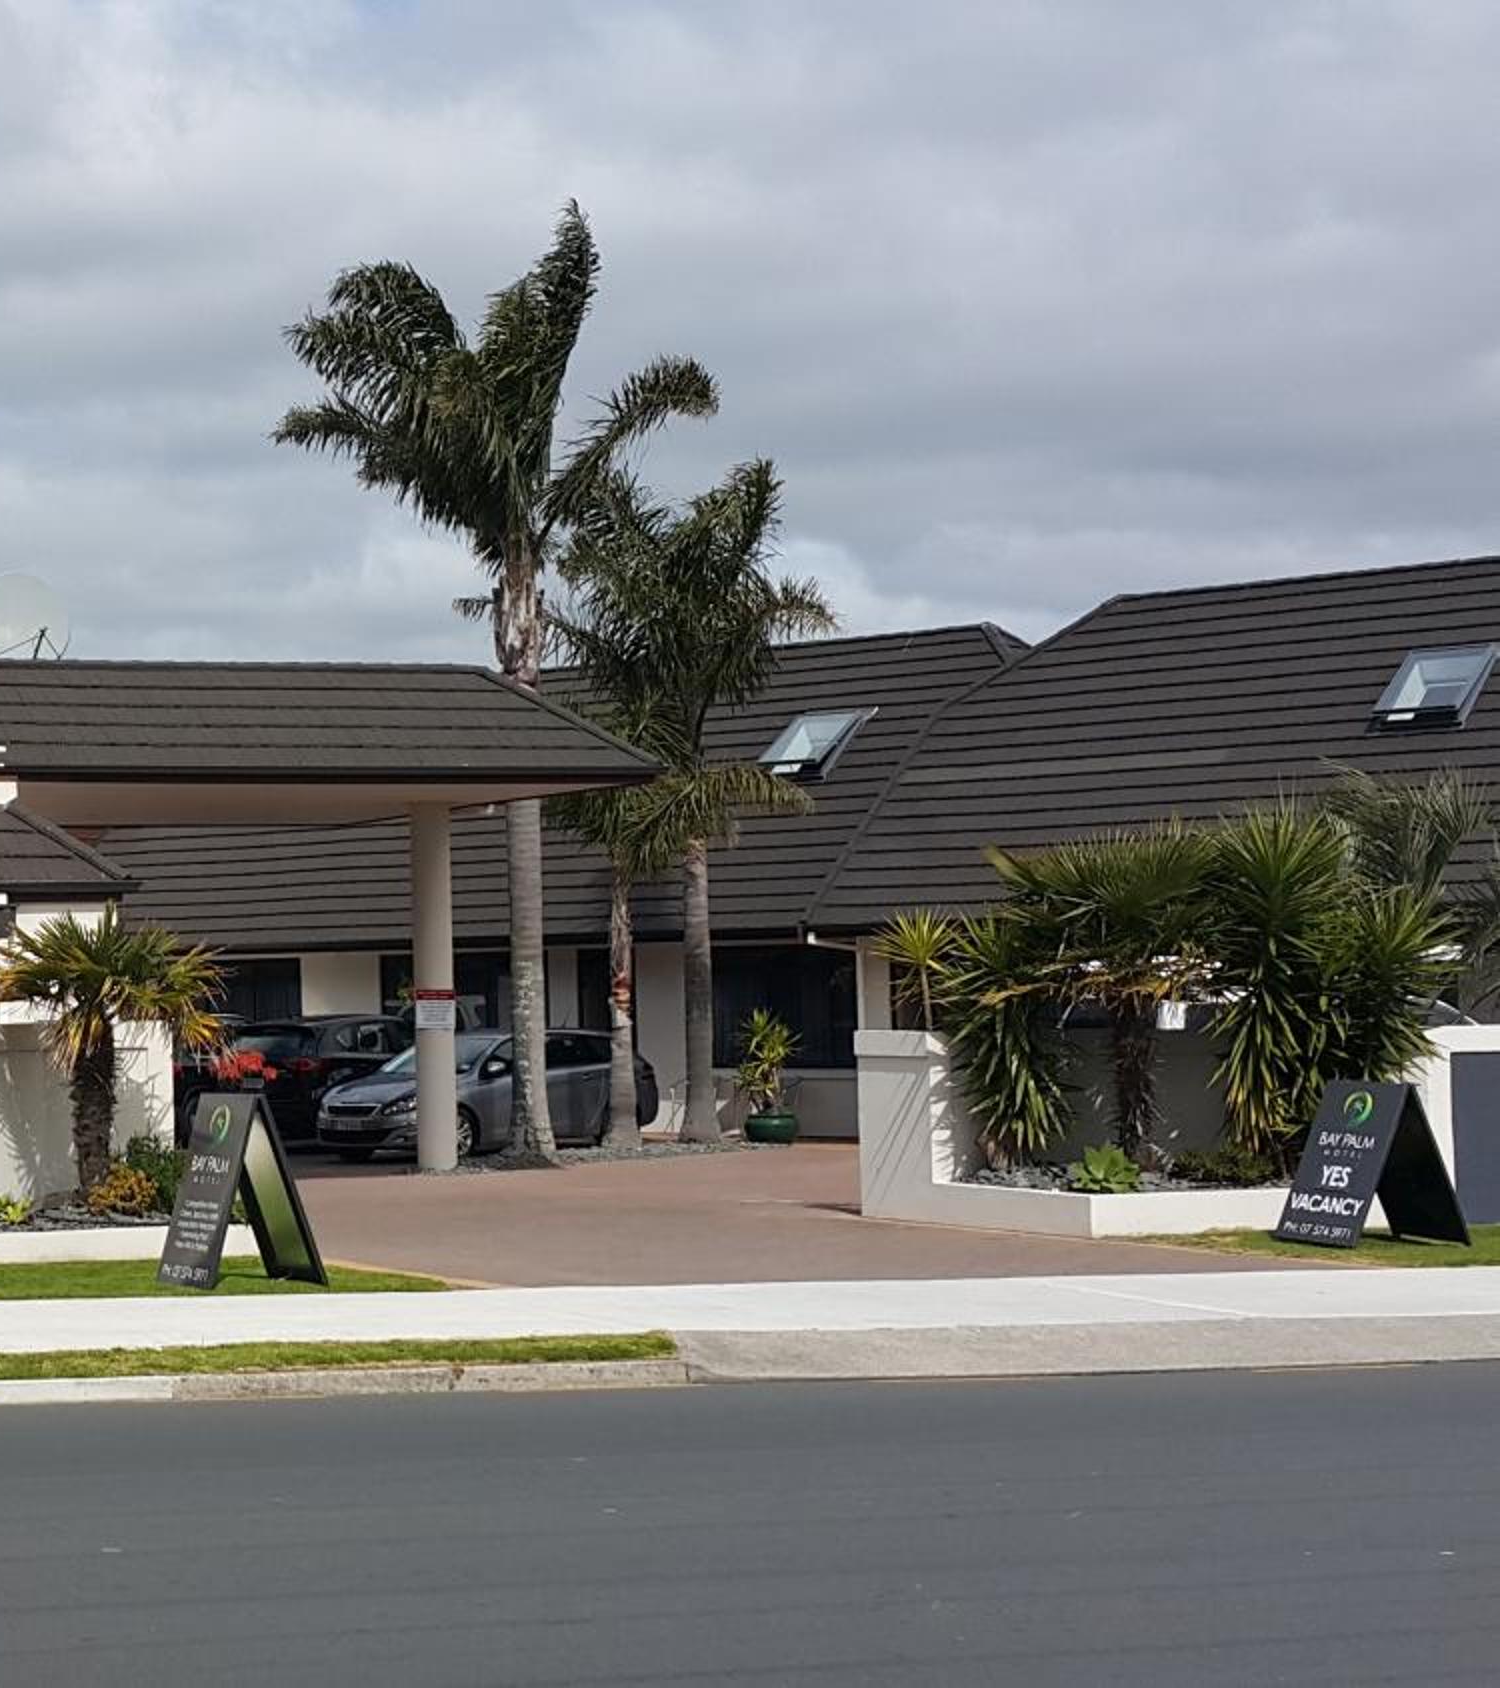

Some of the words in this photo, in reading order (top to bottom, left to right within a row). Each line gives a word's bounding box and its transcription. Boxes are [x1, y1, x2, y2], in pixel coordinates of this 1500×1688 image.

[1318, 1131, 1342, 1147] BAY
[1341, 1133, 1375, 1150] PALM
[191, 1154, 208, 1172] BAY
[206, 1154, 229, 1173] PALM
[1321, 1165, 1352, 1188] YES
[1290, 1191, 1365, 1217] VACANCY
